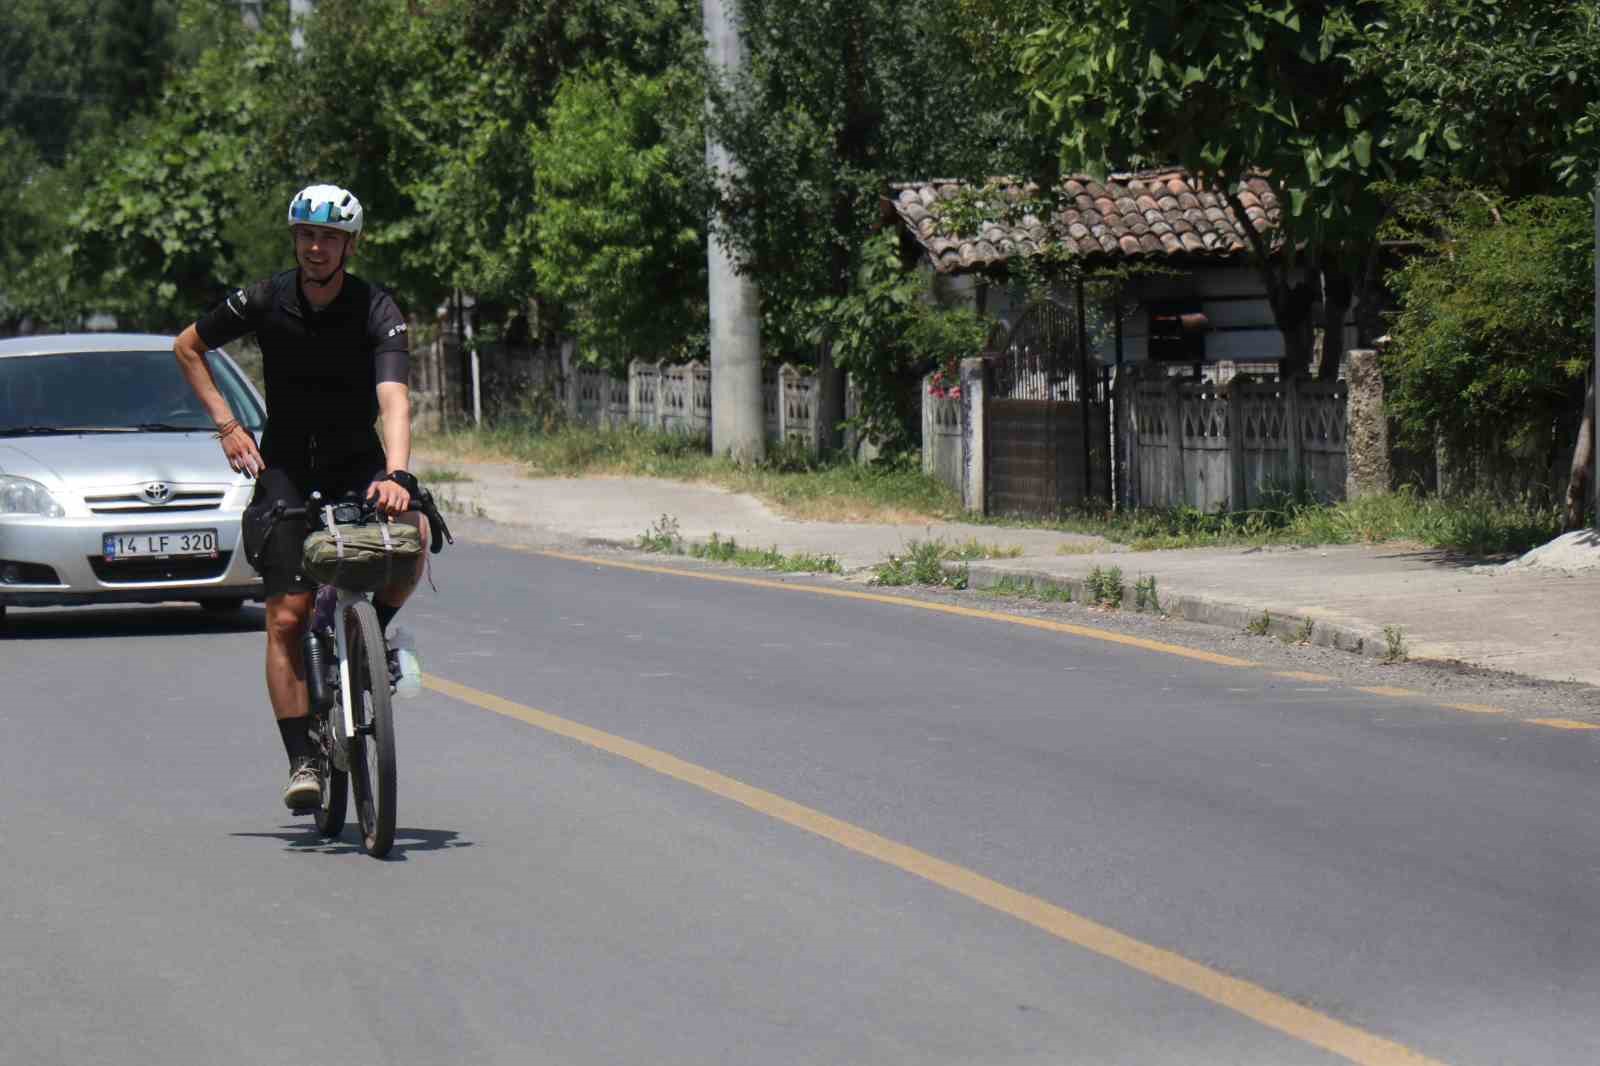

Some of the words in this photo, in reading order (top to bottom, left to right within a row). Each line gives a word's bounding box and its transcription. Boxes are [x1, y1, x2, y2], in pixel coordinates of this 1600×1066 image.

[118, 537, 137, 554] 14
[148, 536, 169, 553] LF
[181, 534, 213, 551] 320
